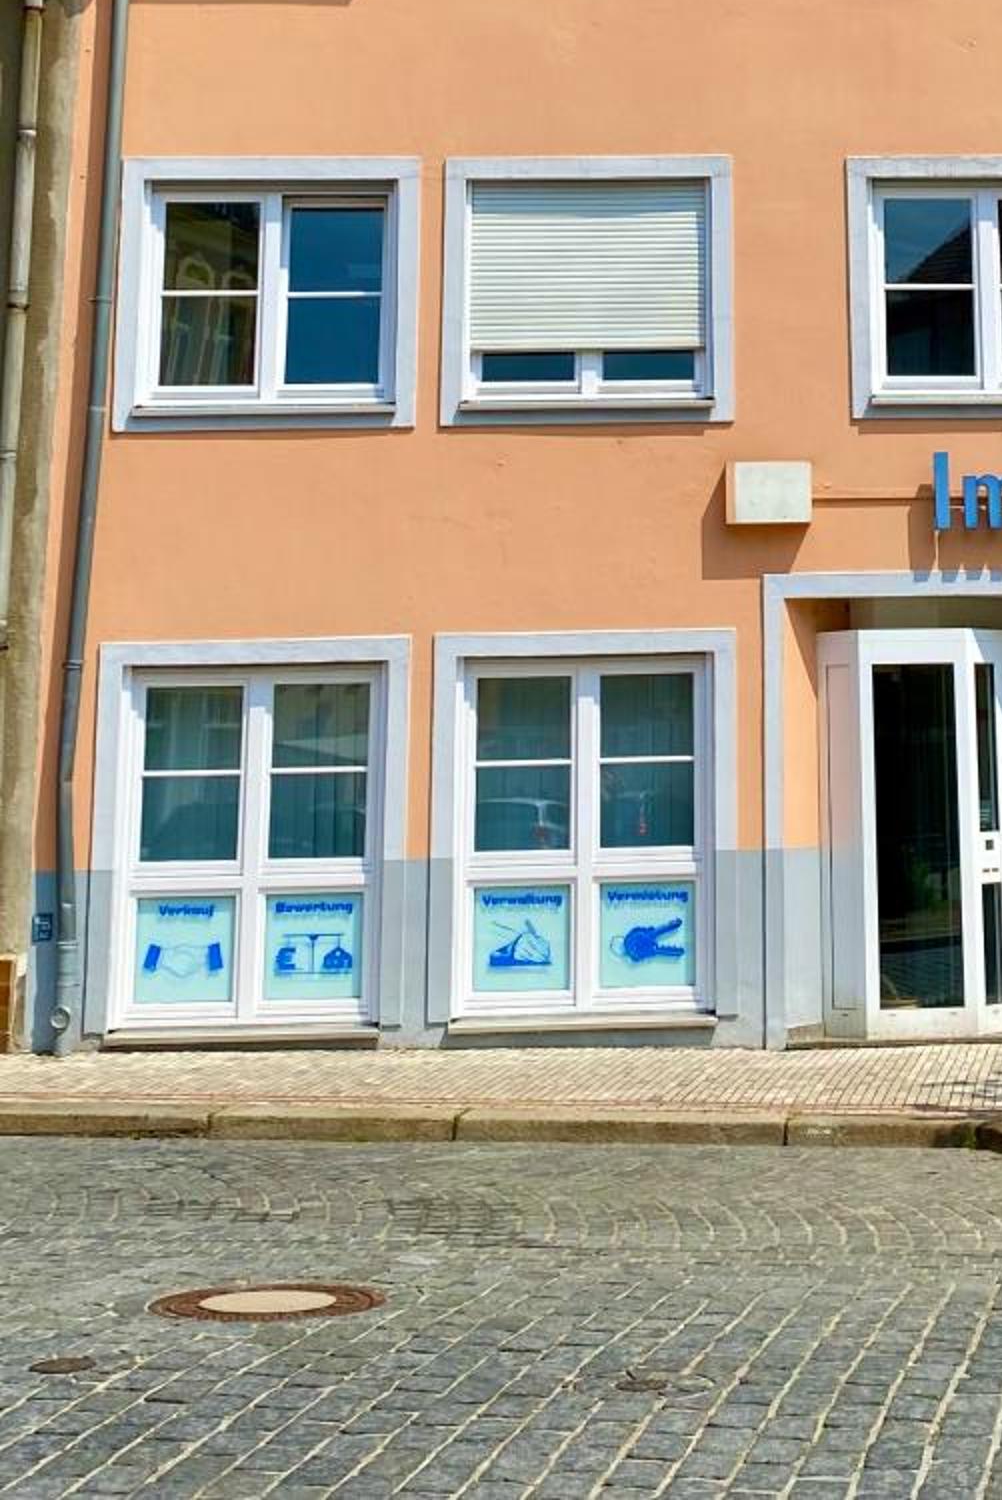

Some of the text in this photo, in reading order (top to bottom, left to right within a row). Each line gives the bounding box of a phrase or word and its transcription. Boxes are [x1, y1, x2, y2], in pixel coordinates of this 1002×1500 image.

[481, 891, 563, 907] Verwaltung
[607, 889, 690, 903] Vermietung
[158, 903, 216, 917] Verkauf
[275, 900, 354, 915] Bewertung
